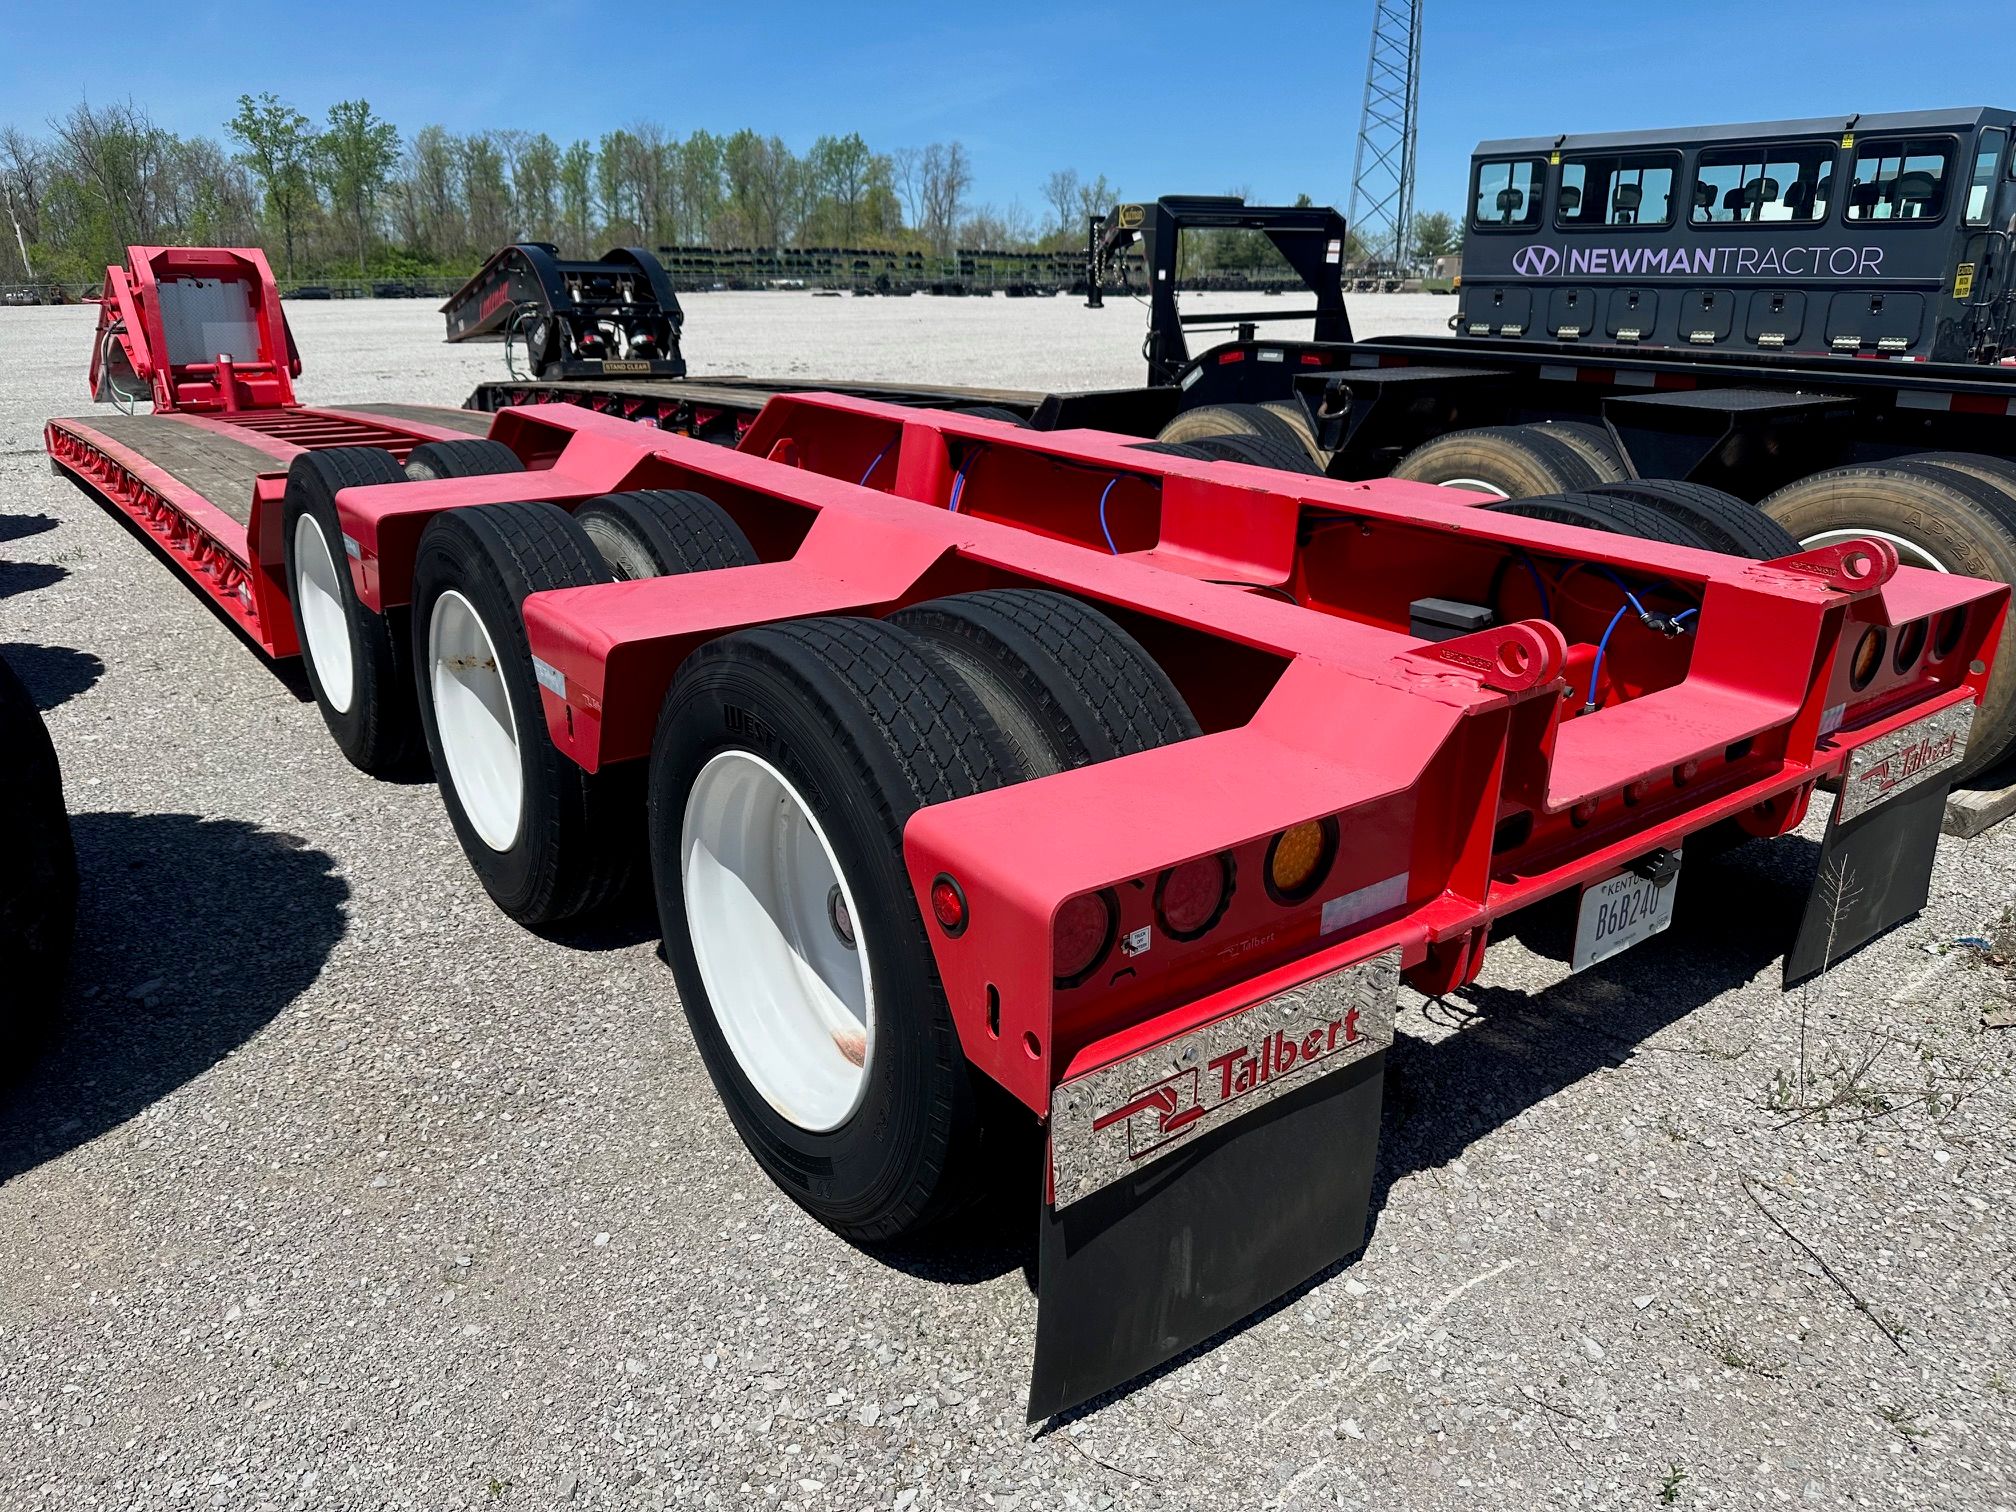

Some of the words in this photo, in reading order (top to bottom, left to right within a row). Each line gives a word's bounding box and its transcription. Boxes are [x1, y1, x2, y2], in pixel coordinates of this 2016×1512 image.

[1898, 731, 1956, 776] Talbert
[1608, 874, 1645, 896] KENTU
[1240, 932, 1275, 951] Talbert
[1208, 1005, 1360, 1100] Talbert
